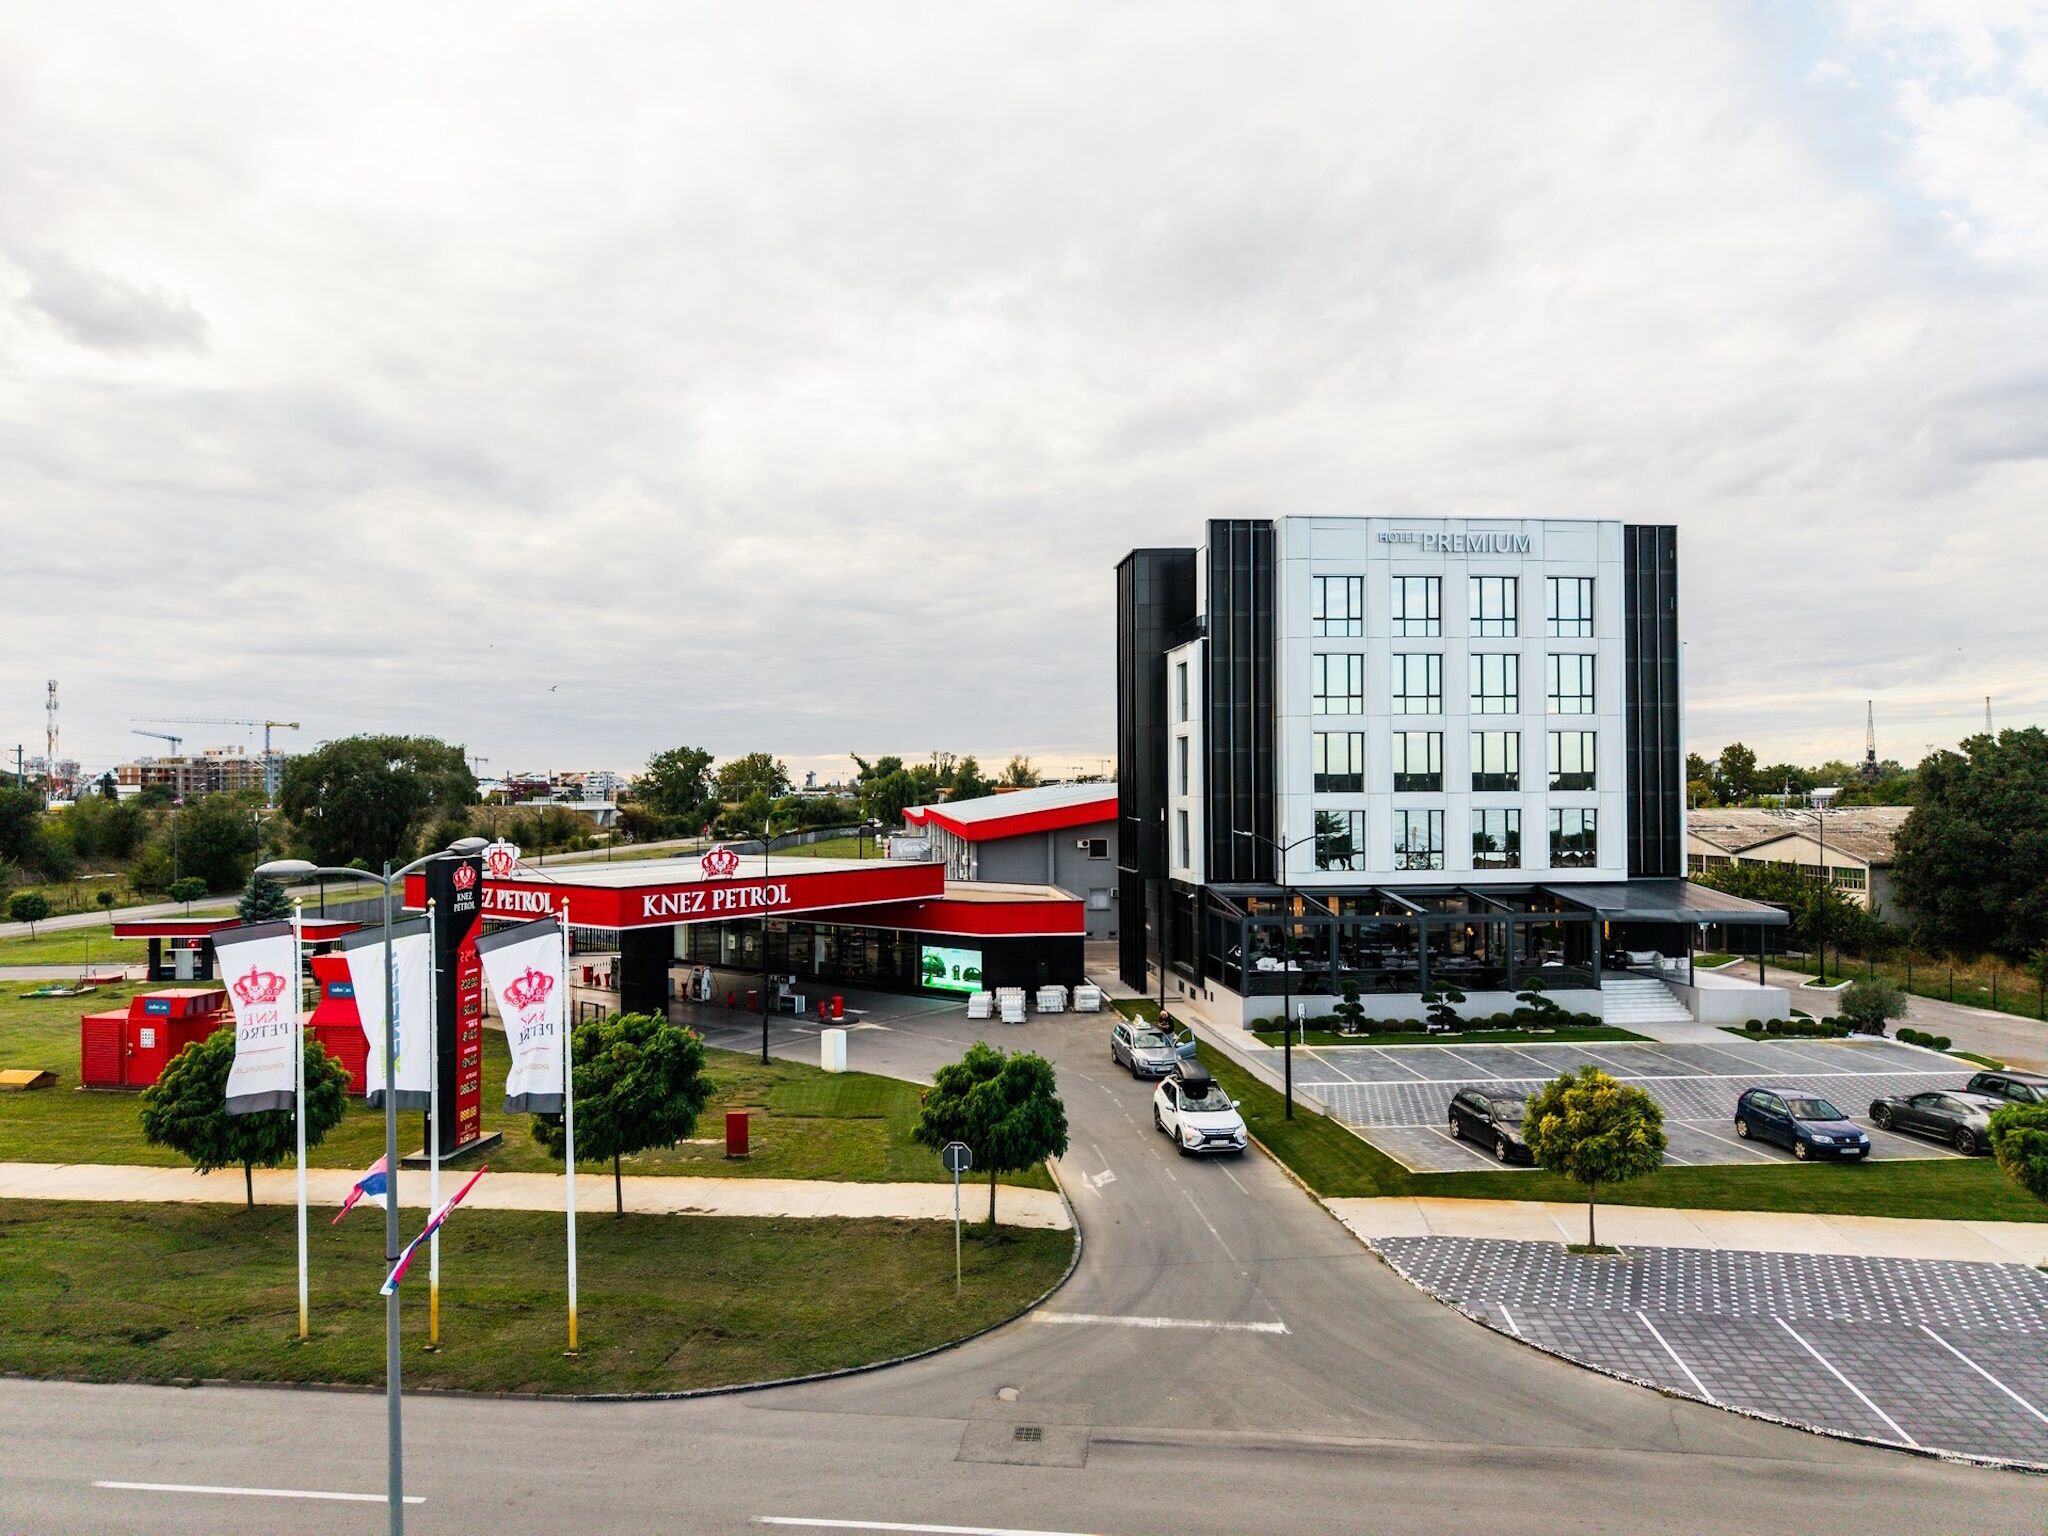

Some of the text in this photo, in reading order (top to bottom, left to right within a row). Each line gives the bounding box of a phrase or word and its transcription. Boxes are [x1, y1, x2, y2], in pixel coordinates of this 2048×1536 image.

[1378, 532, 1532, 553] HOTEL PREMIUM
[453, 901, 476, 912] PETROL
[456, 891, 473, 902] KNEZ
[496, 889, 554, 913] PETROL
[642, 884, 791, 917] KNEZ PETROL
